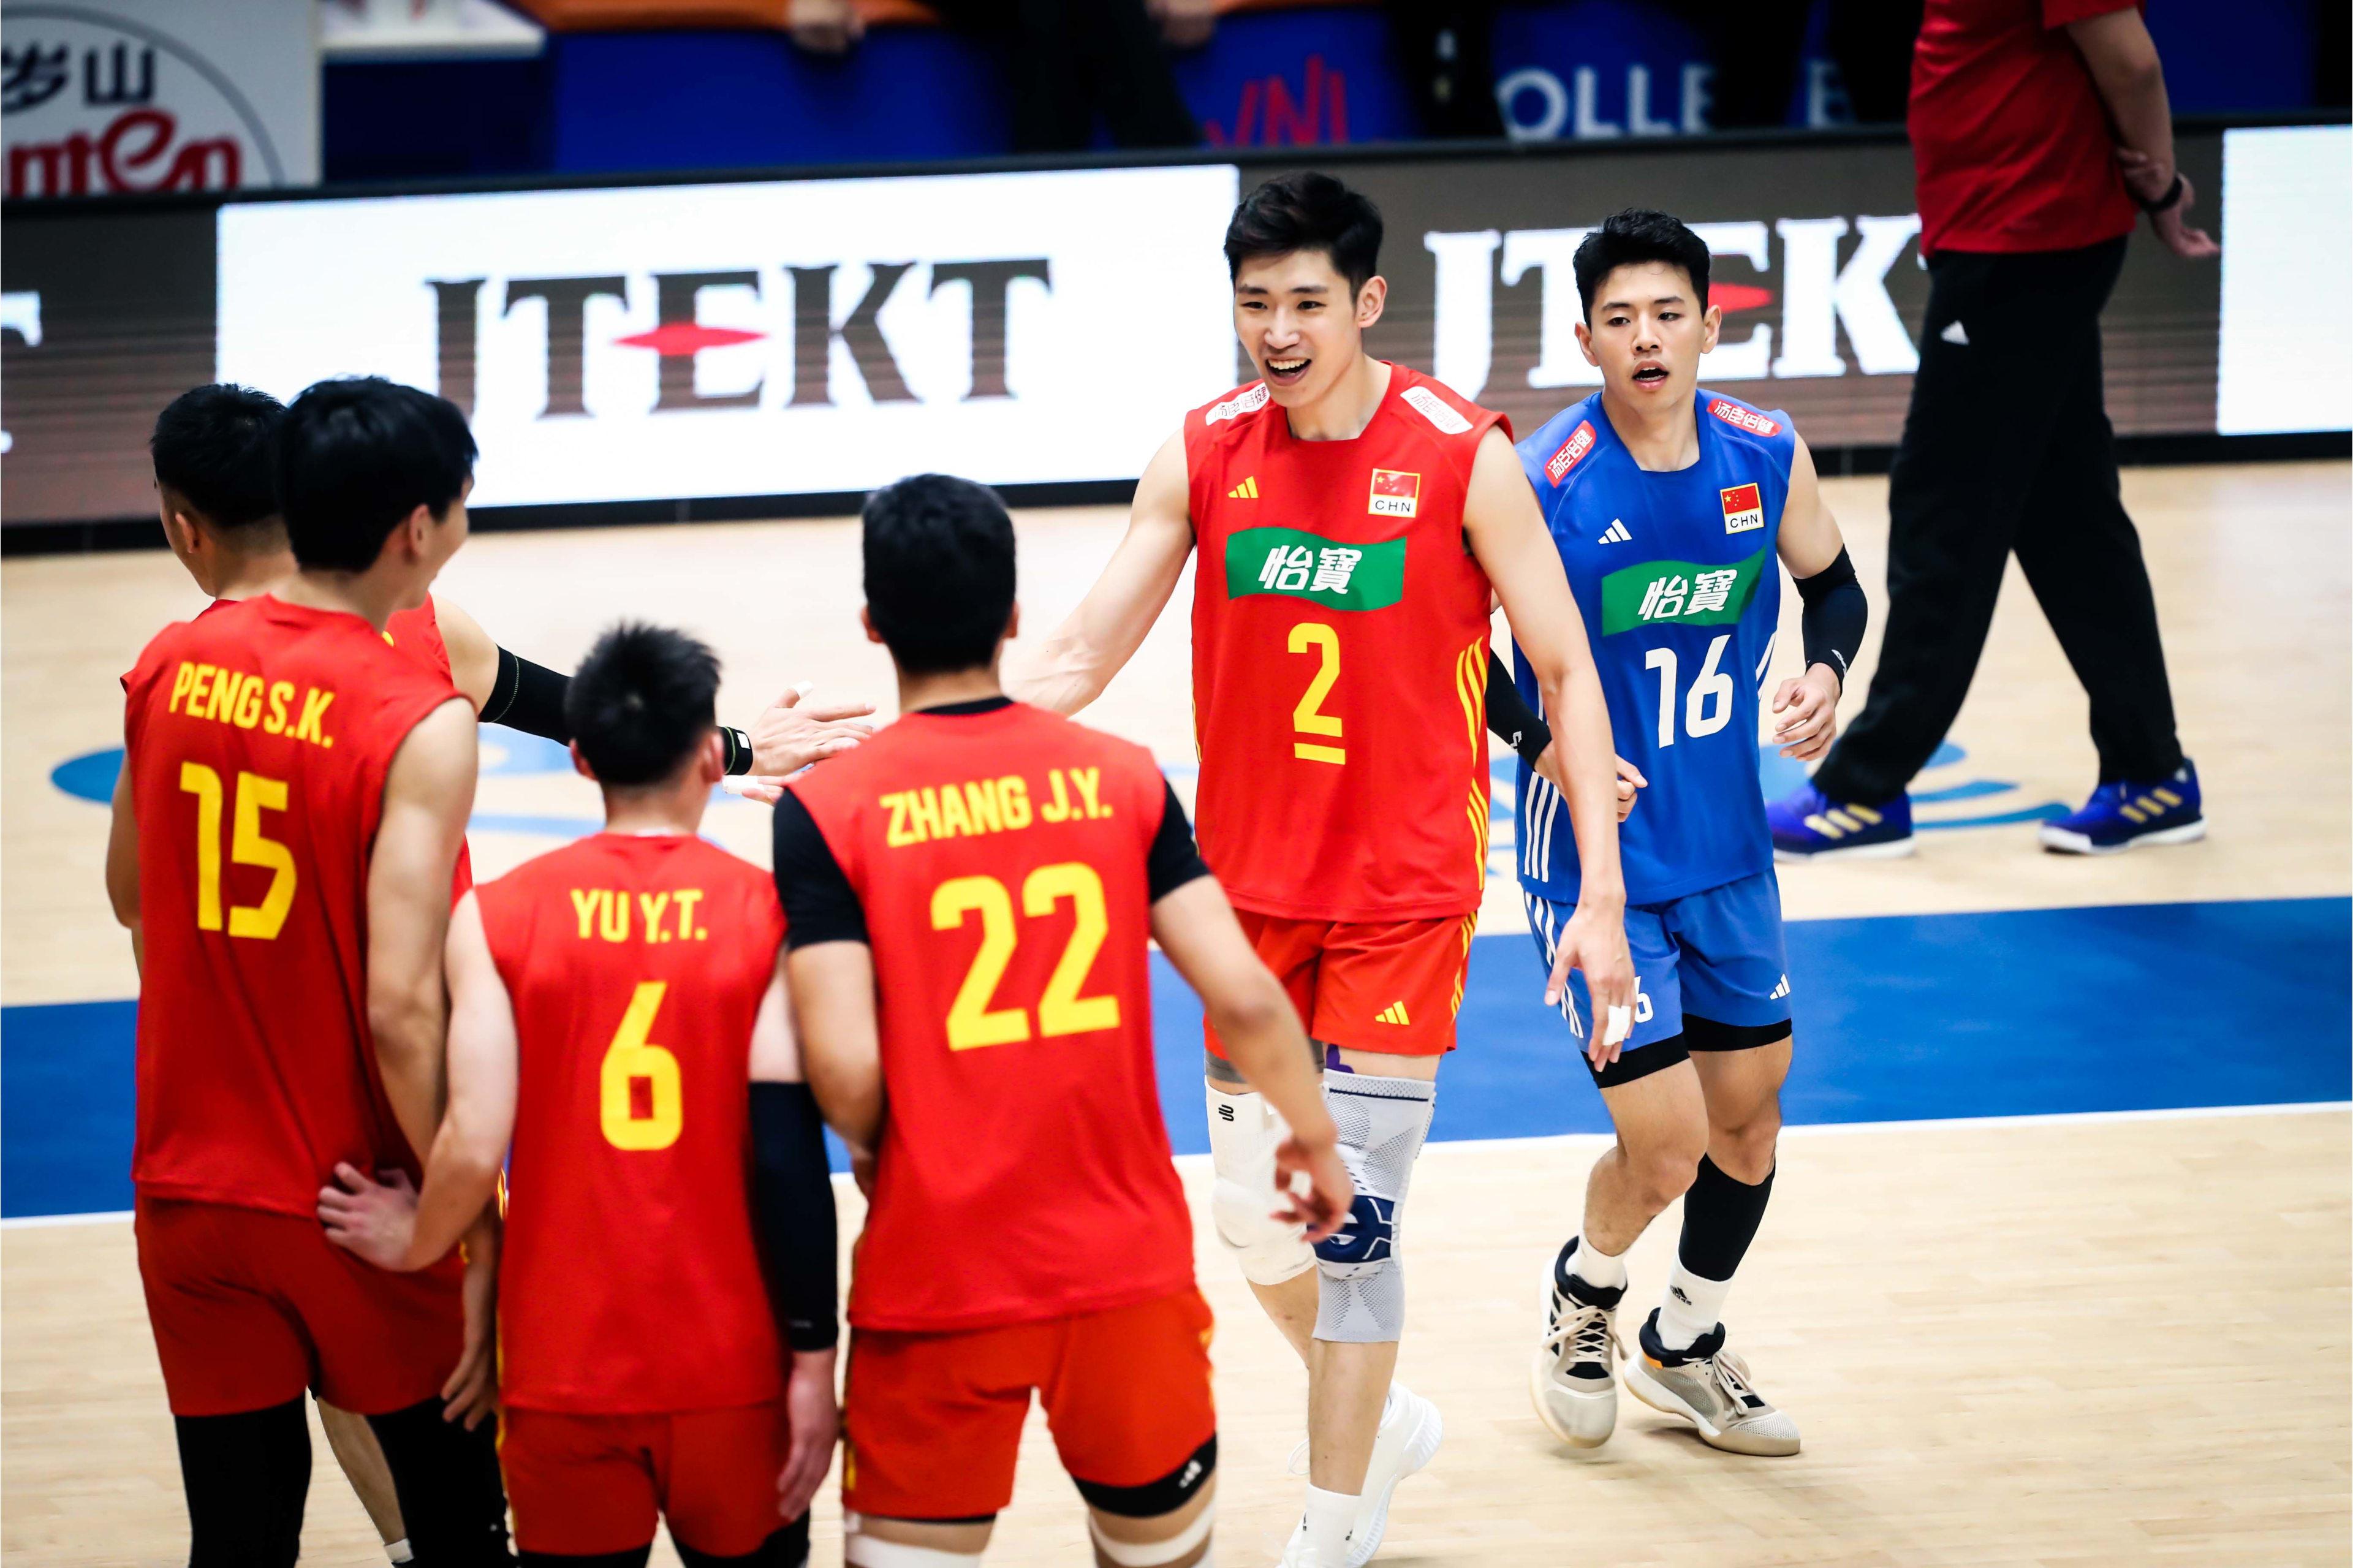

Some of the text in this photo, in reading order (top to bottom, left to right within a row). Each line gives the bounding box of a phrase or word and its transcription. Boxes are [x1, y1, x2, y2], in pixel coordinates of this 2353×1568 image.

[424, 257, 1053, 424] JTEKT
[1423, 214, 1928, 402] JTEK
[1547, 429, 1593, 479] 汤臣倍健
[1714, 401, 1775, 434] 汤臣倍健
[1375, 499, 1411, 513] CHN
[1730, 513, 1759, 528] CHN
[1258, 545, 1363, 594] 怡寶
[1637, 569, 1738, 621] 怡寶
[1287, 622, 1343, 738] 2
[1645, 634, 1733, 749] 16
[879, 766, 1113, 847] ZHANG J.Y.
[180, 761, 297, 941] 15
[570, 888, 708, 944] YU Y.T.
[930, 862, 1121, 1052] 22
[600, 980, 683, 1151] 6
